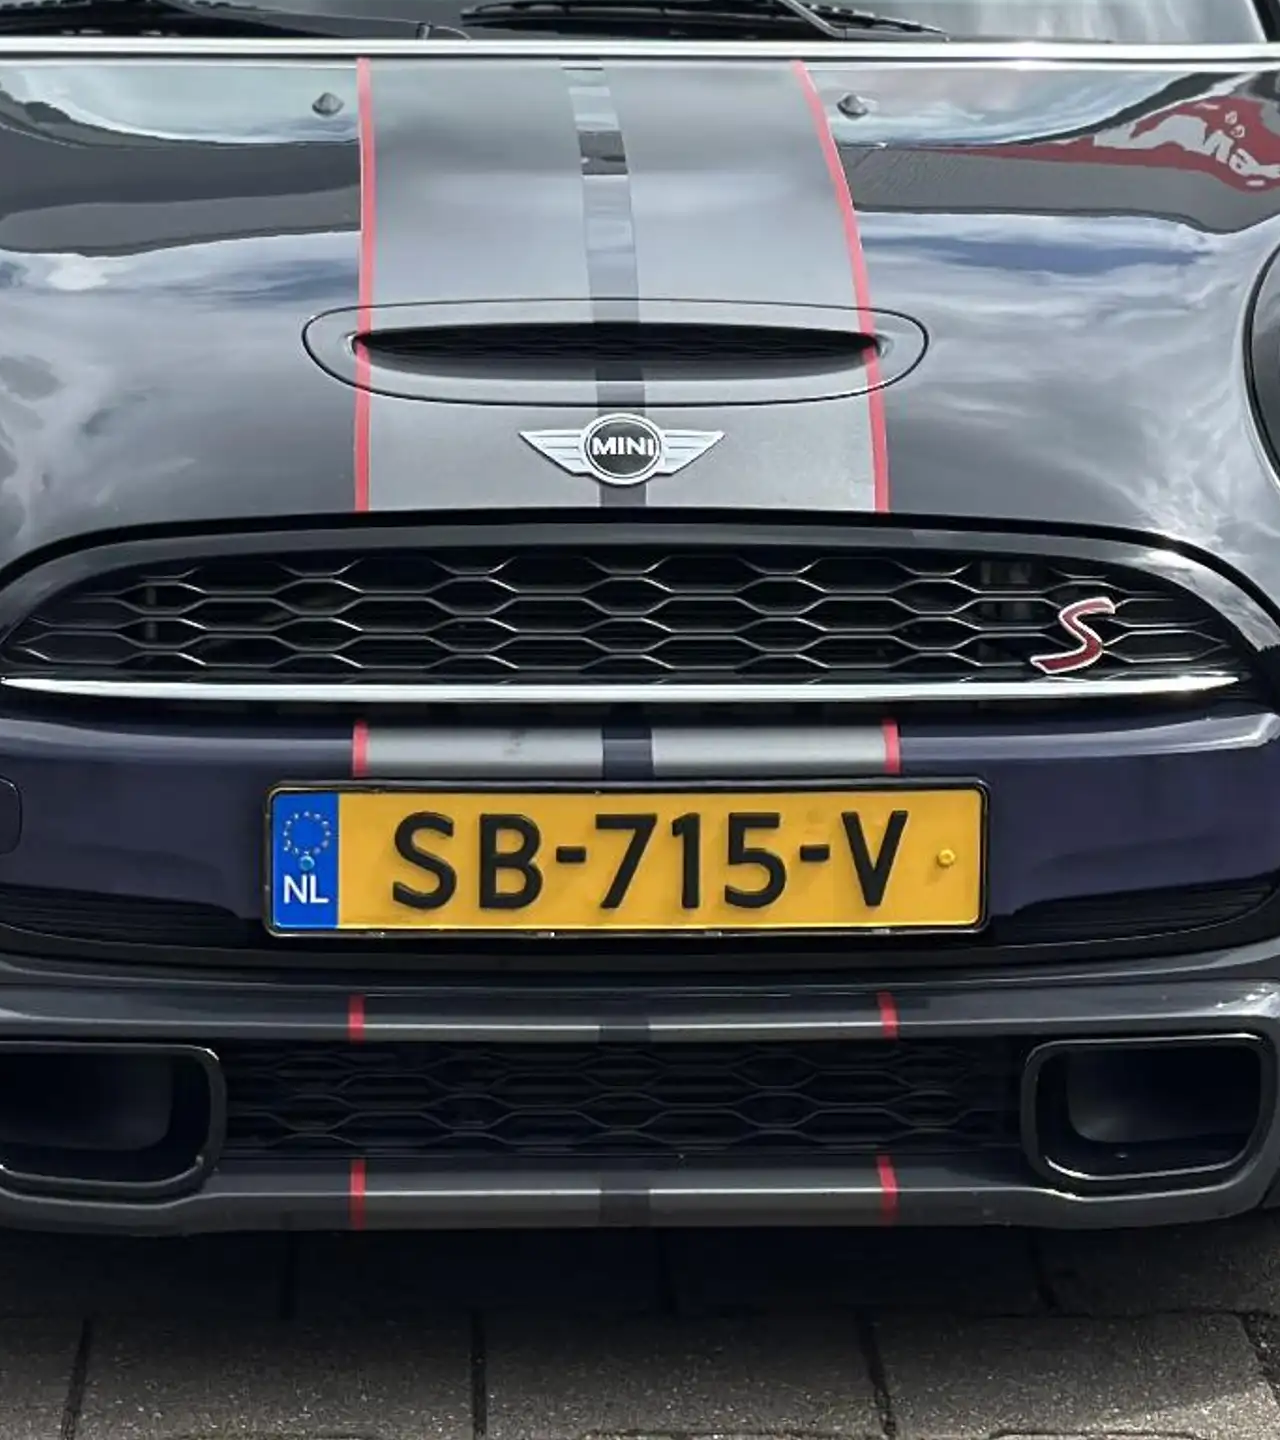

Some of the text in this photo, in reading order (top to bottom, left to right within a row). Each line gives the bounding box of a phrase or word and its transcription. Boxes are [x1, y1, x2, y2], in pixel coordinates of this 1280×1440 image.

[592, 436, 655, 456] MINI
[1030, 596, 1116, 674] S
[283, 808, 910, 912] NL SB-715-V
